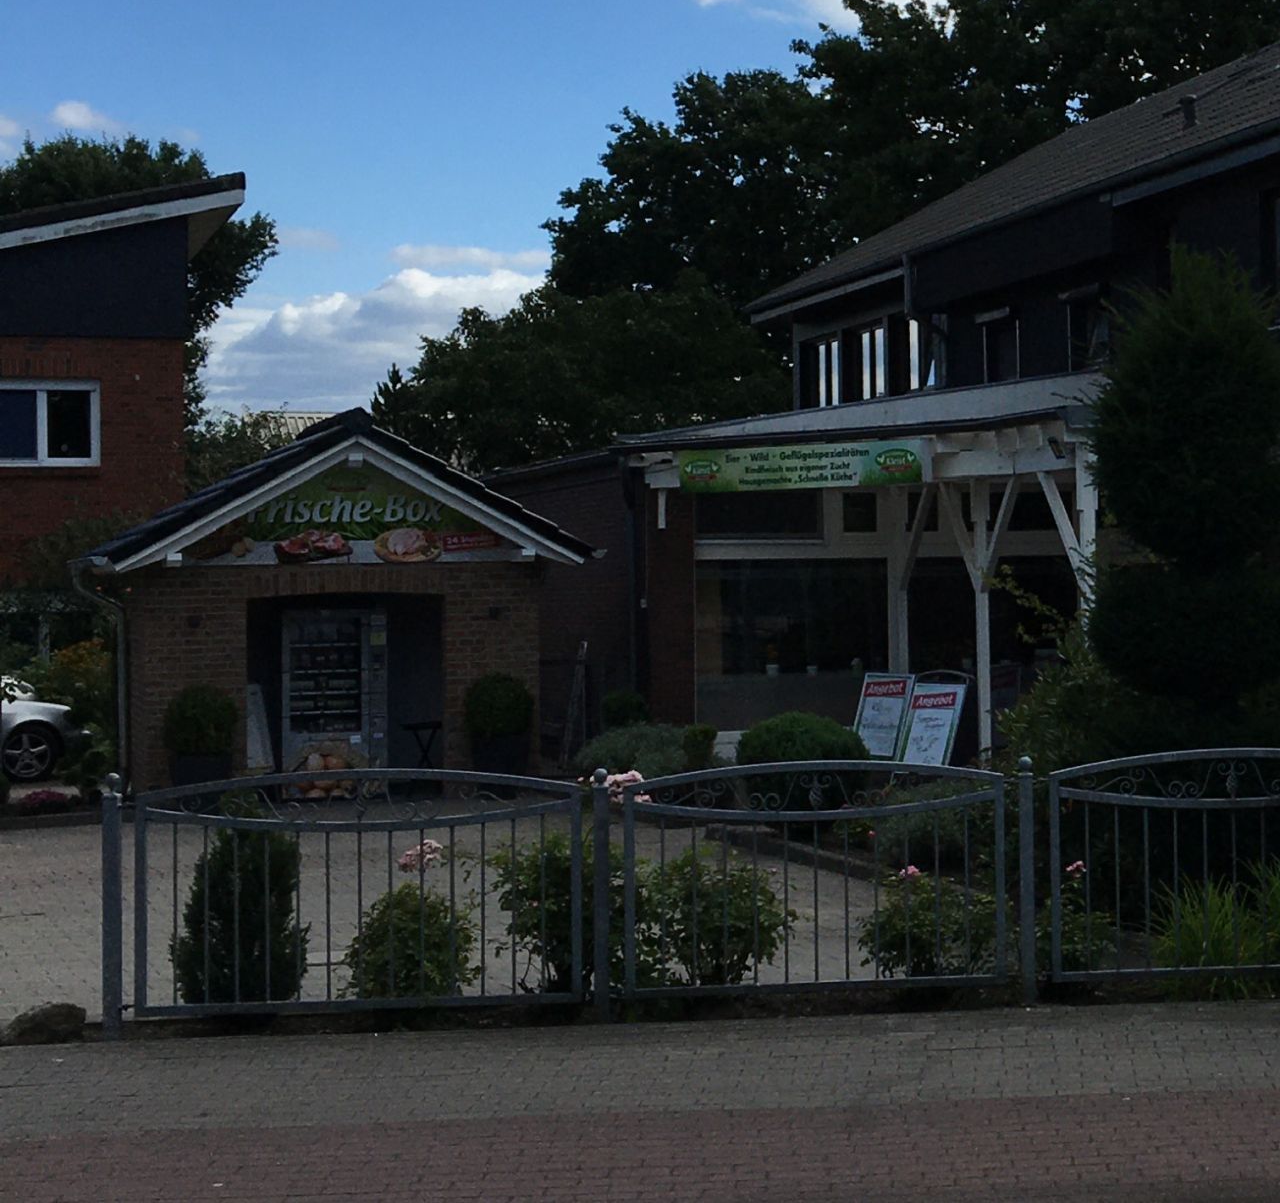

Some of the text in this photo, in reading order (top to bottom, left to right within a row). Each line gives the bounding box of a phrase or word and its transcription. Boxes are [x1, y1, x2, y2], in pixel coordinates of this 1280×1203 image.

[725, 447, 870, 463] Eier Wild Geflügelspezialitäten
[865, 681, 904, 696] Angebot
[916, 694, 954, 707] Angebot
